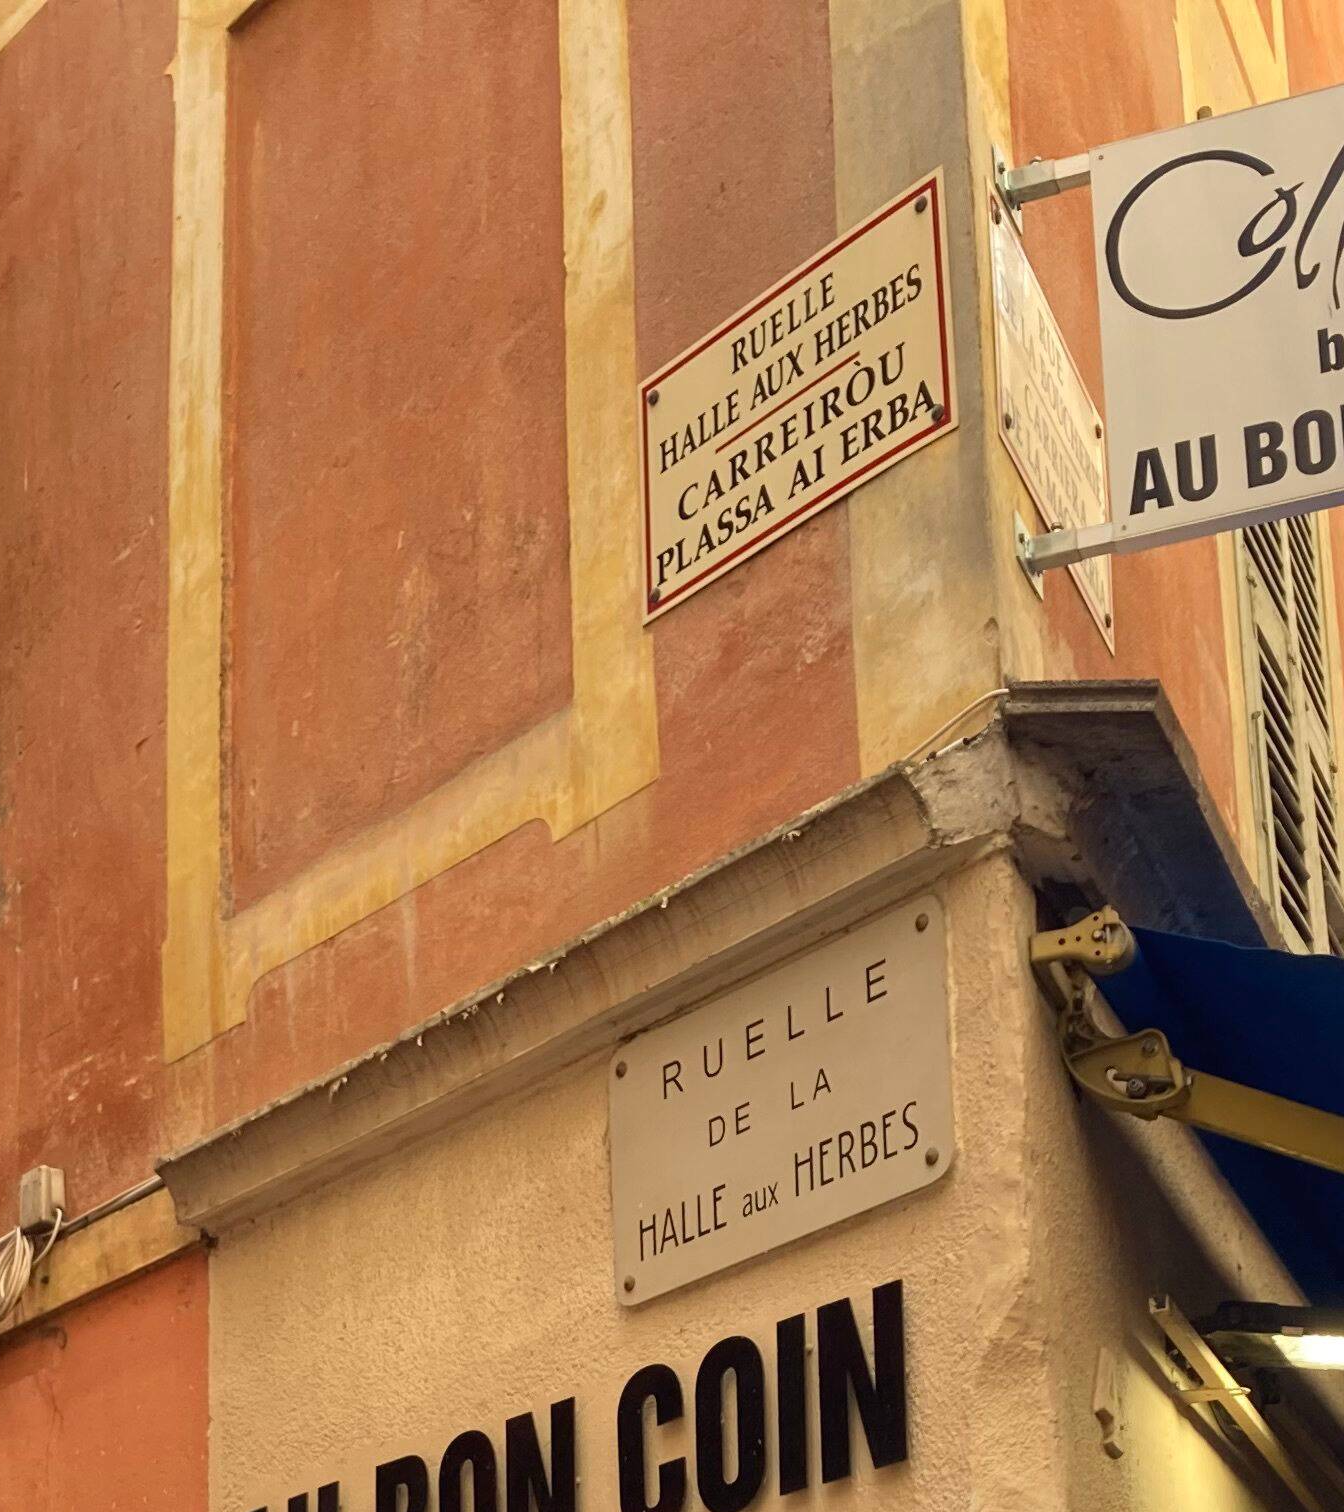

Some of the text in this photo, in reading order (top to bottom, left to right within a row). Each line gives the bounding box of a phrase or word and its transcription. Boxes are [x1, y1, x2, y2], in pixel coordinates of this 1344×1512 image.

[659, 263, 923, 475] HALLE AUX HERBES
[732, 272, 836, 375] RUELLE
[1020, 312, 1038, 375] LA
[1037, 305, 1064, 388] RUE
[655, 379, 939, 588] PLASSA AI ERBA
[678, 342, 906, 521] CARREIRÒU
[1129, 434, 1220, 516] AU
[662, 958, 888, 1100] RUELLE
[709, 1068, 832, 1148] DE LA
[639, 1101, 919, 1262] HALLE aux HERBES
